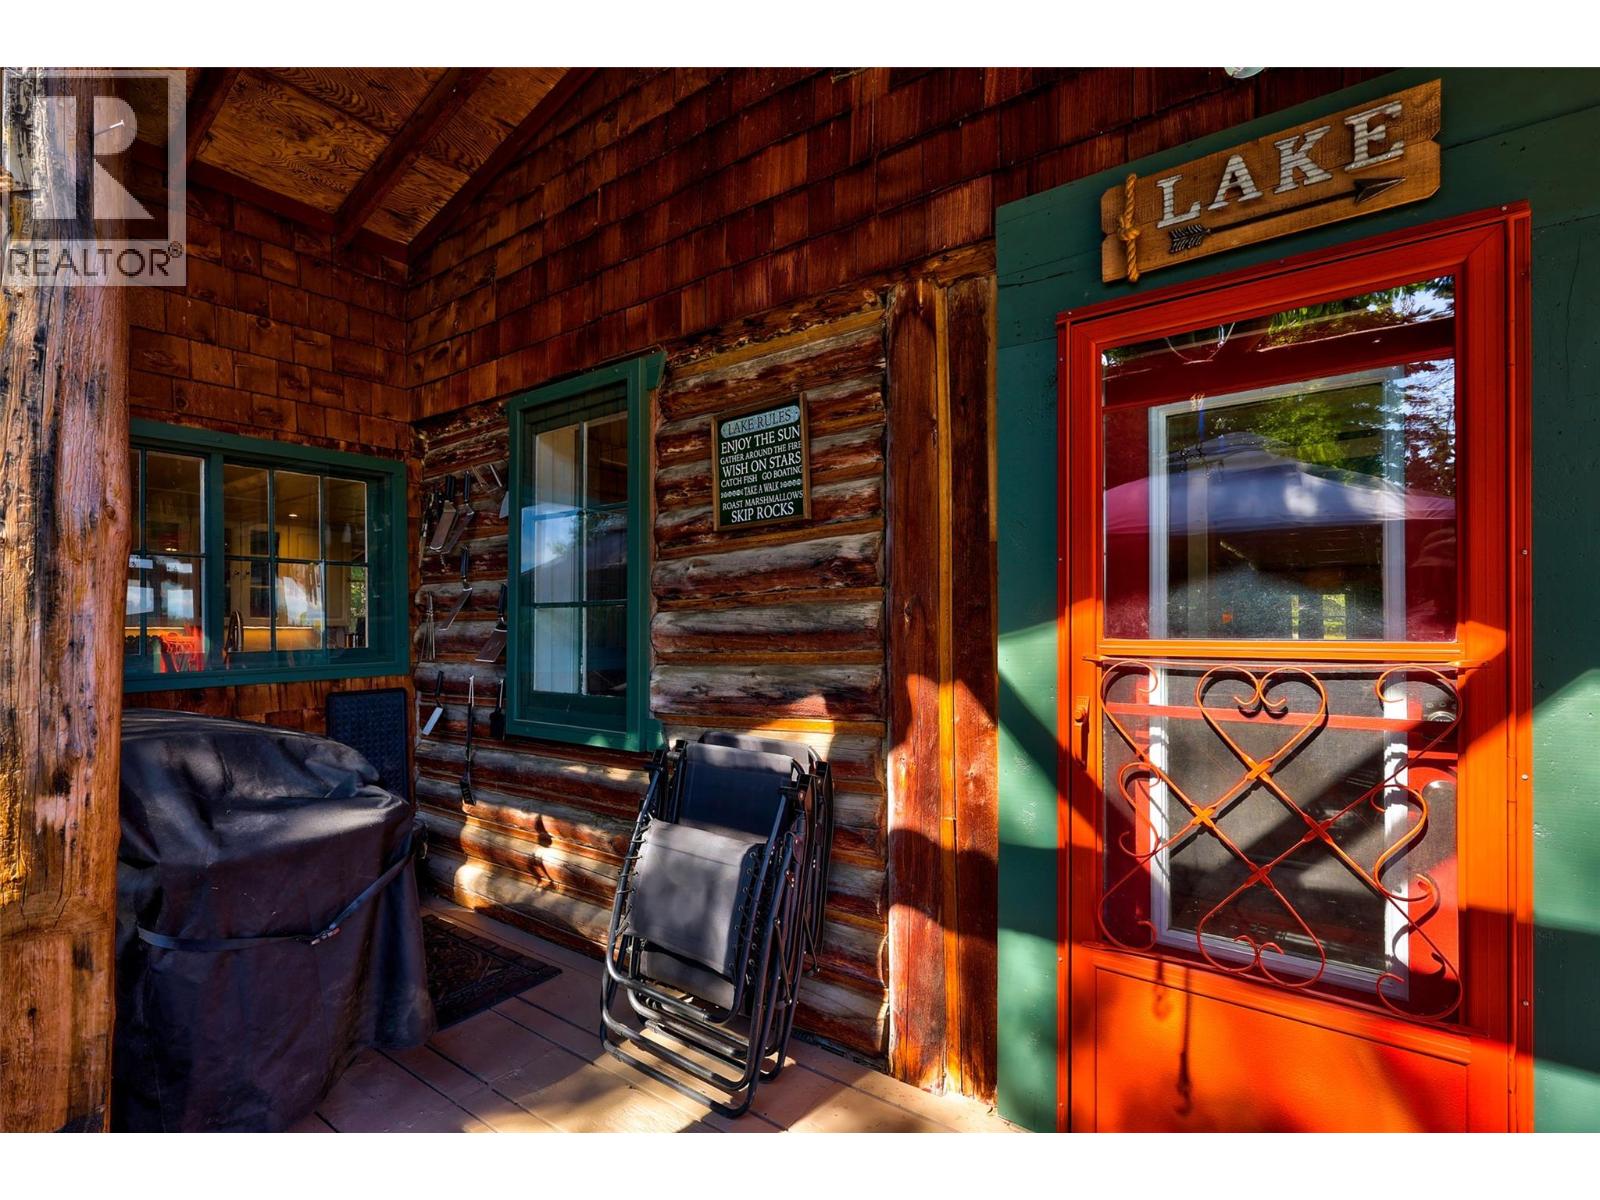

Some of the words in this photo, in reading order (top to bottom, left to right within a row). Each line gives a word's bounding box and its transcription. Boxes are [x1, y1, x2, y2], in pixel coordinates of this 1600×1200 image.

[1156, 101, 1405, 228] LAKE
[728, 418, 755, 436] LAKE
[757, 409, 792, 428] RULES
[721, 436, 752, 454] ENJOY
[754, 431, 776, 447] THE
[777, 425, 801, 441] SUN
[720, 453, 745, 465] GATHER
[745, 447, 773, 459] AROUND
[774, 443, 787, 453] THE
[787, 441, 802, 451] FIRE
[722, 462, 748, 478] WISH
[750, 458, 767, 472] ON
[769, 451, 802, 469] STARS
[720, 477, 742, 488] CATCH
[743, 474, 758, 484] FISH
[761, 471, 773, 480] GO
[773, 465, 802, 478] BOATING
[744, 485, 758, 496] TAKE
[758, 484, 763, 494] A
[763, 481, 779, 492] WALK
[722, 500, 743, 511] ROAST
[744, 490, 804, 507] MARSHMALLOWS
[731, 507, 754, 523] SKIP
[756, 501, 795, 520] ROCKS
